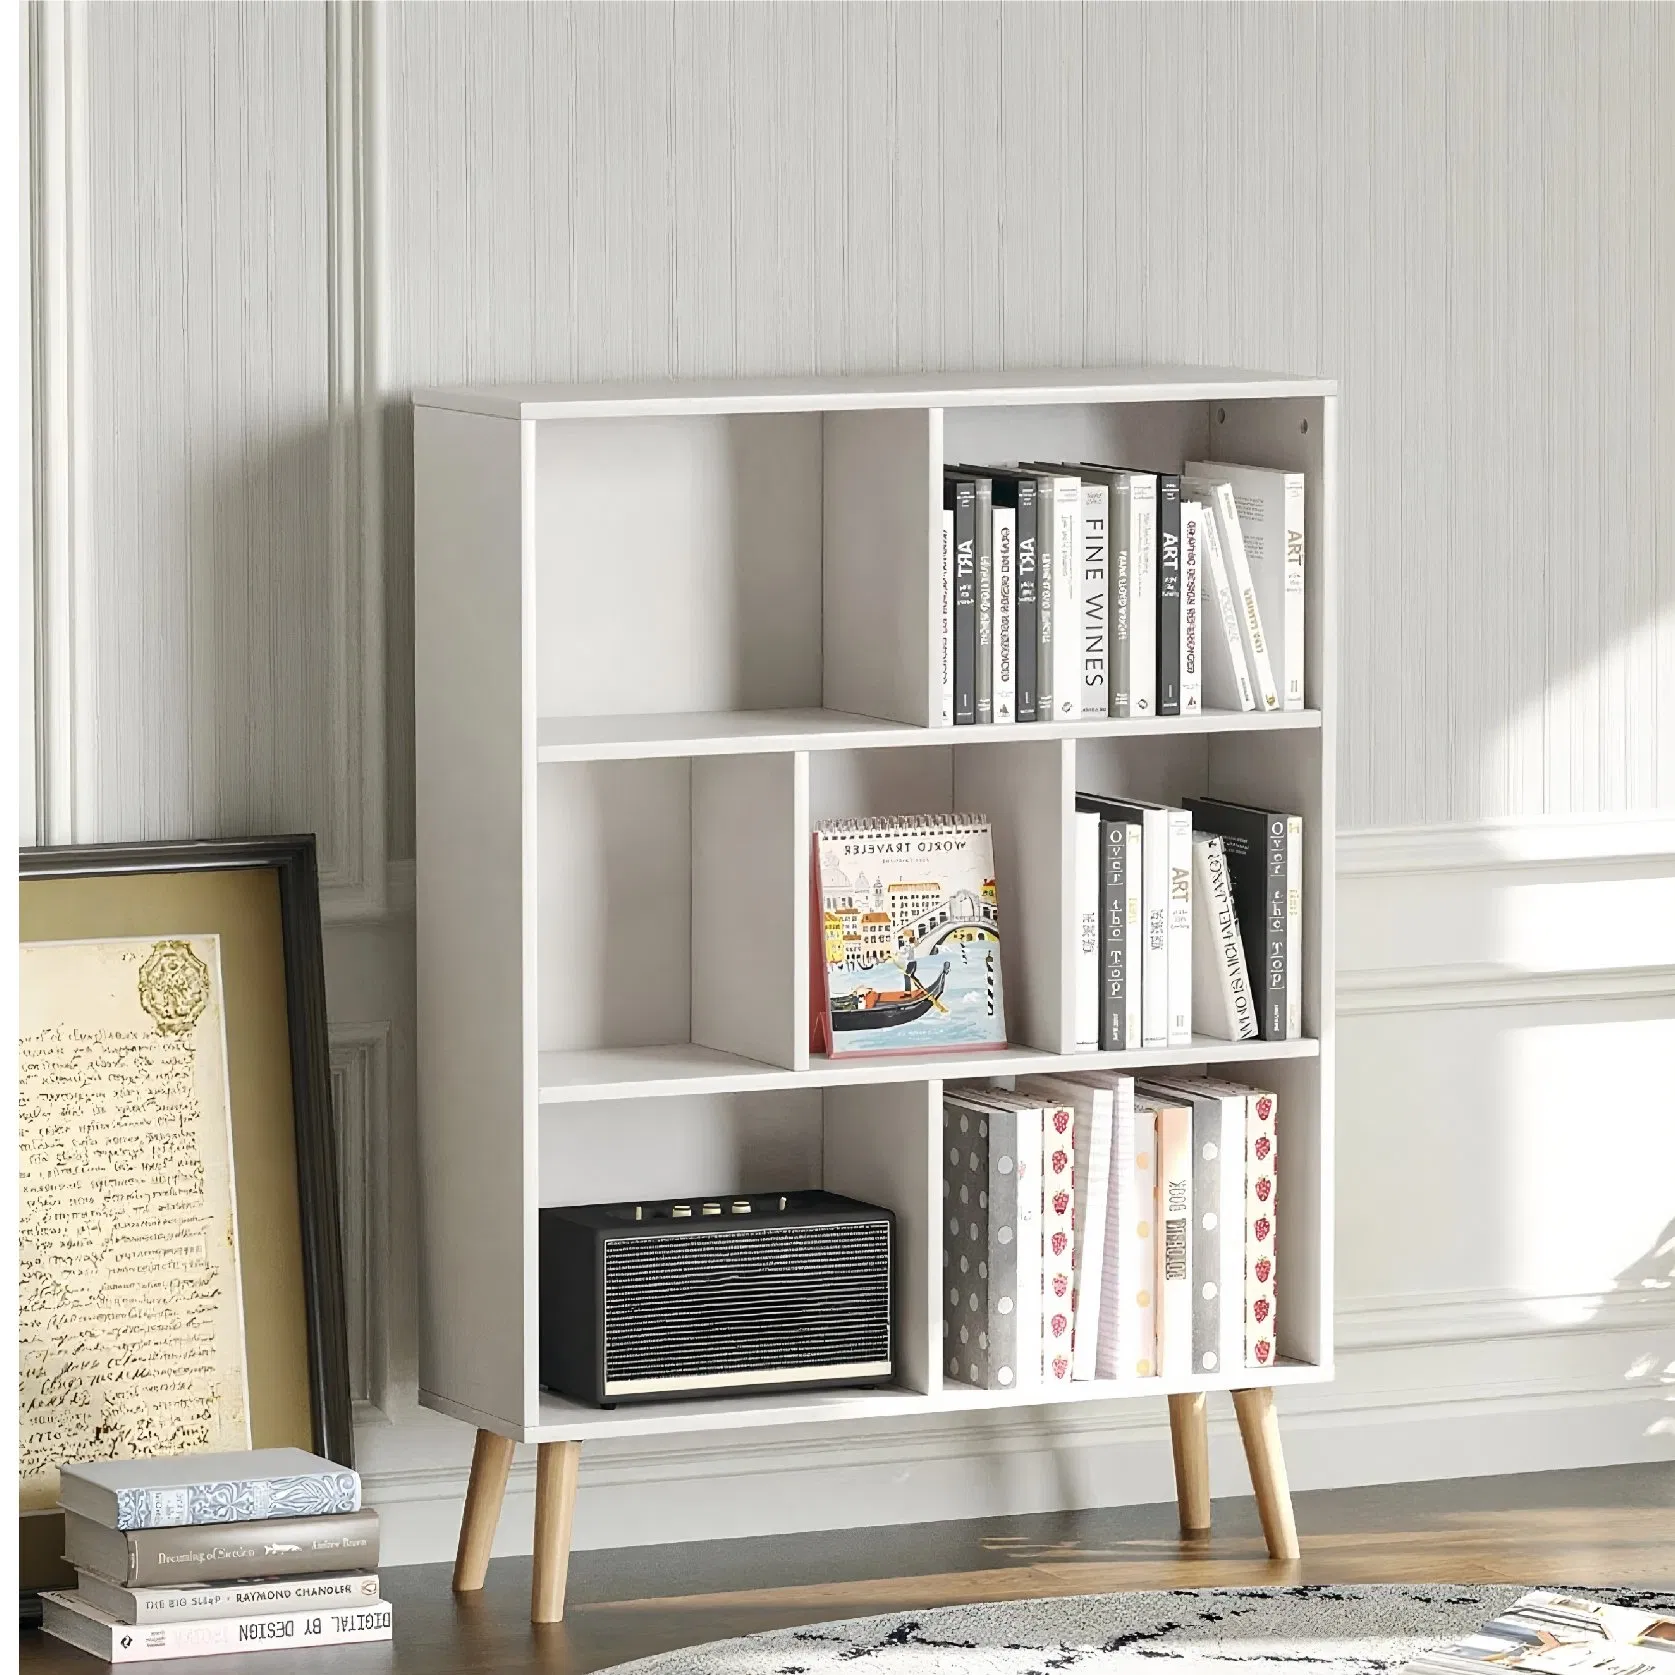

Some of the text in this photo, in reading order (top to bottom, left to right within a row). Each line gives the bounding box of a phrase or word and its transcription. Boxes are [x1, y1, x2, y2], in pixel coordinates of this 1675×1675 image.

[1085, 518, 1104, 581] FINE
[1162, 532, 1179, 571] ART
[1287, 530, 1303, 566] ART
[1085, 593, 1104, 688] WINES
[1171, 867, 1189, 904] ART
[146, 1599, 165, 1610] THE
[169, 1597, 187, 1609] BIG
[236, 1589, 291, 1603] RAYMOND
[295, 1584, 352, 1598] CHANDLER
[239, 1620, 294, 1642] DESIGN
[303, 1617, 322, 1636] BY
[330, 1612, 391, 1633] DIGITAL
